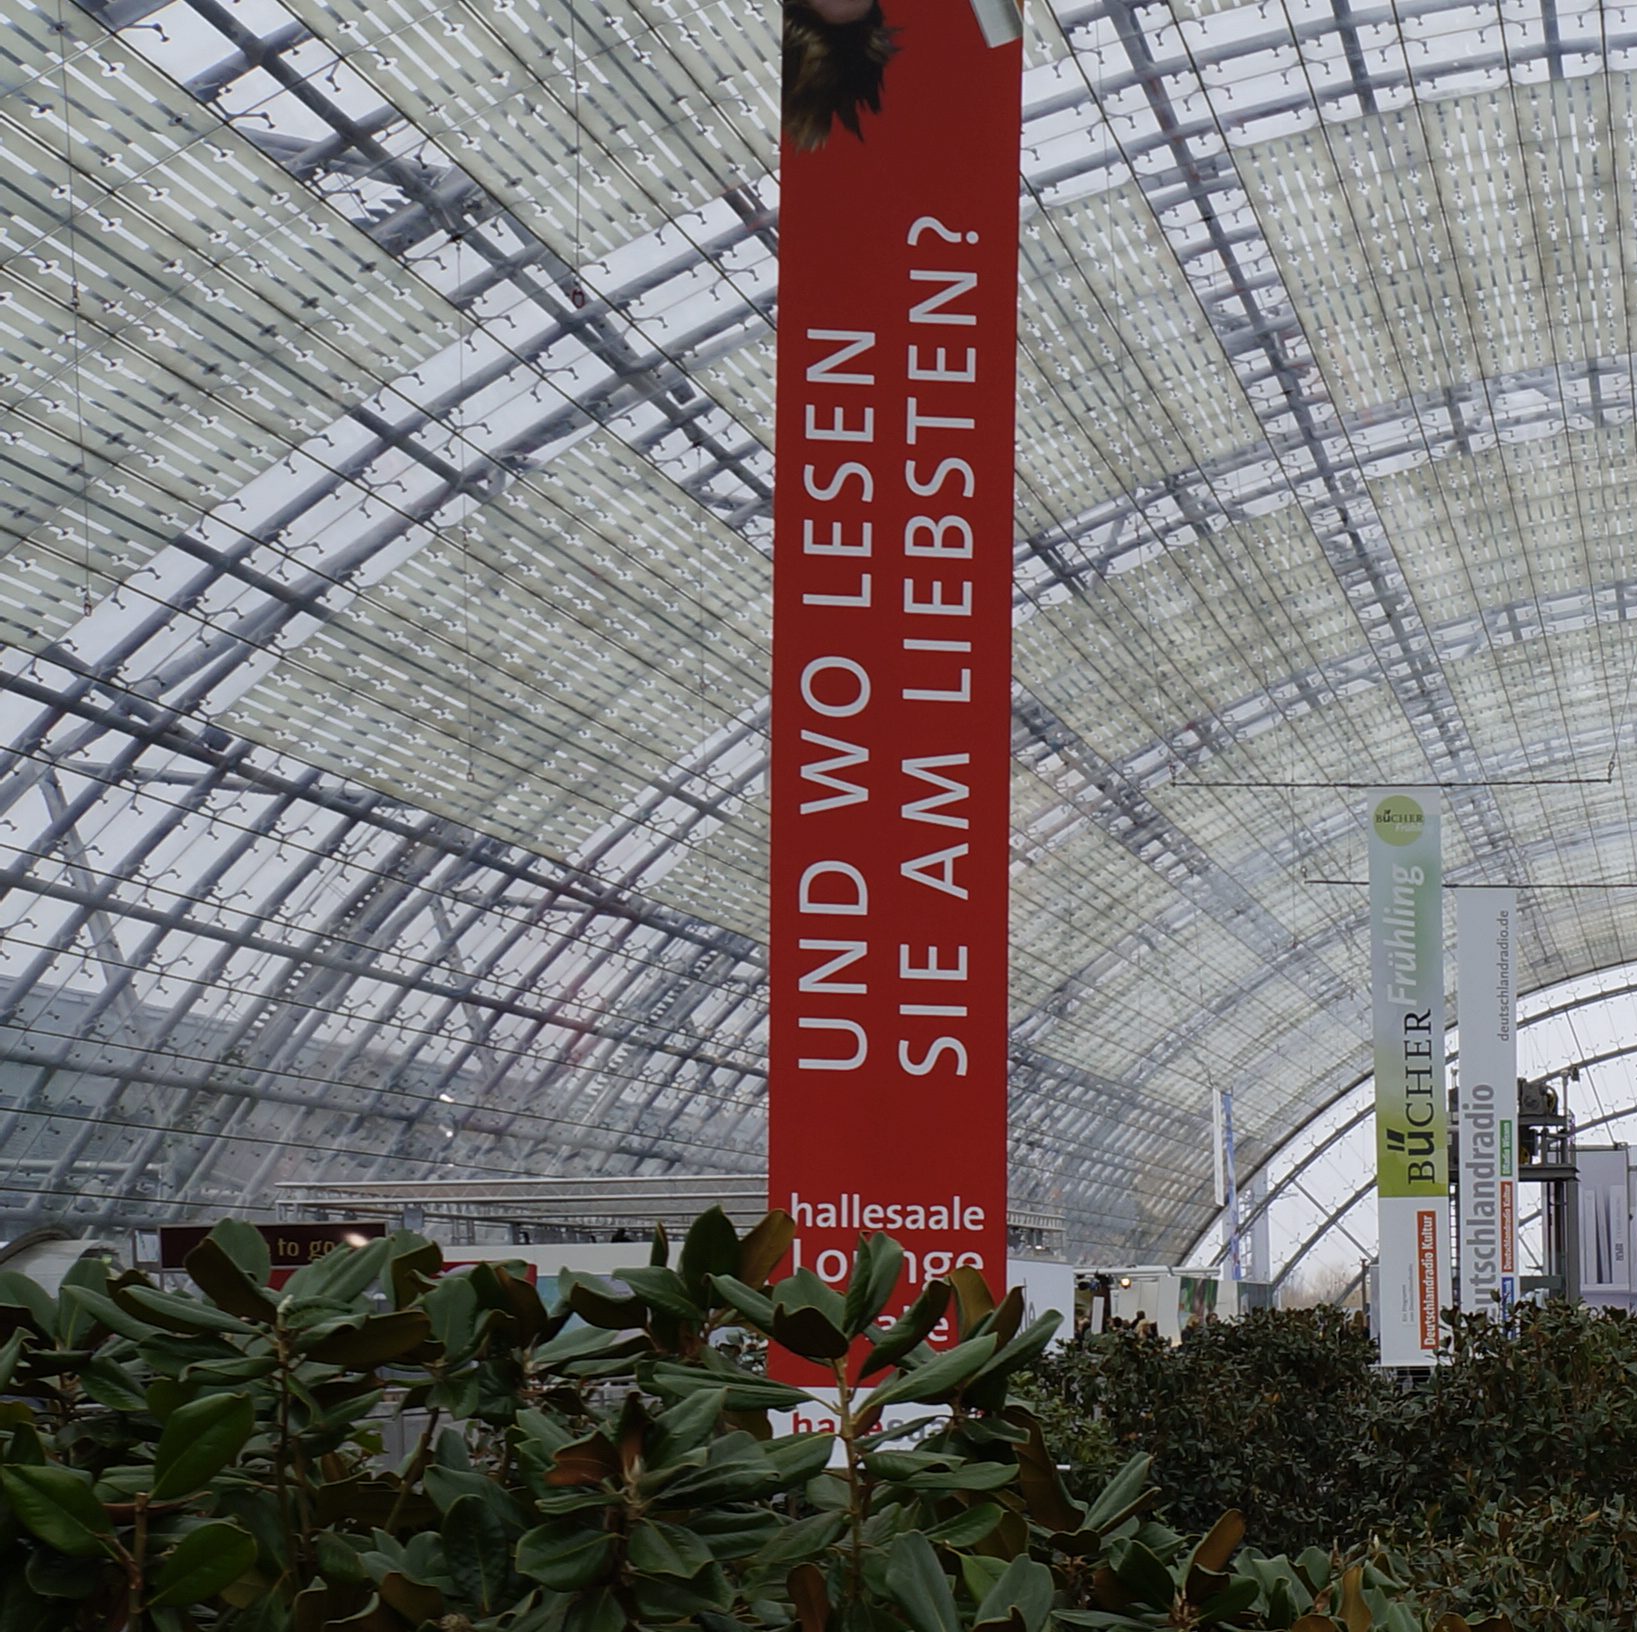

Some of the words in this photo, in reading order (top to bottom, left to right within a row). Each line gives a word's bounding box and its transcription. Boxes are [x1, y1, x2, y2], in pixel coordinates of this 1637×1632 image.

[803, 327, 876, 608] LESEN
[904, 214, 981, 703] LIEBSTEN?
[800, 654, 872, 815] WO
[900, 752, 971, 902] AM
[799, 859, 868, 1072] UND
[1382, 862, 1425, 1007] Frühling
[1496, 909, 1510, 1042] deutschlandradio.de
[899, 944, 969, 1078] SIE
[1386, 1009, 1436, 1184] BÜCHER
[790, 1192, 986, 1232] hallesaale
[792, 1238, 984, 1292] Longe
[1421, 1214, 1434, 1250] Kultur
[1462, 1083, 1497, 1318] utschlandradio
[1421, 1251, 1437, 1346] Deutschlandradio
